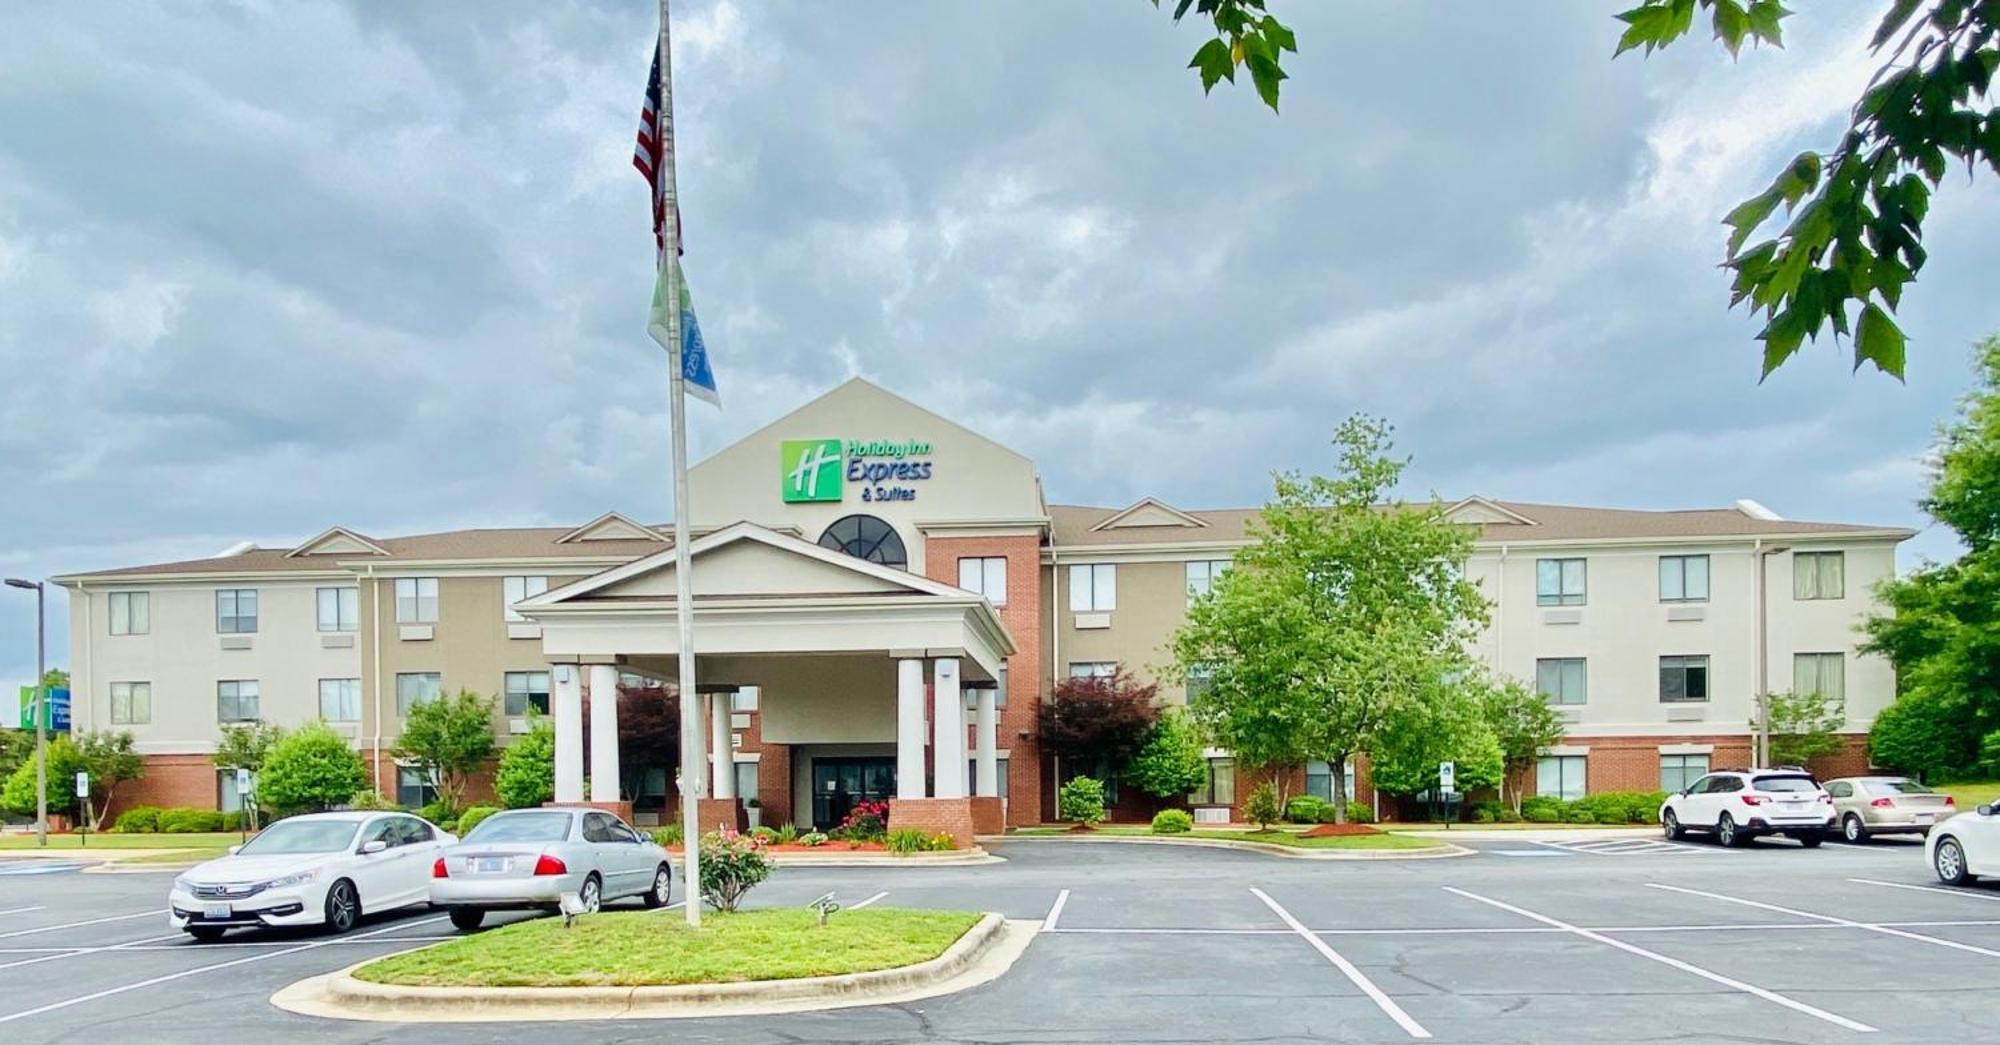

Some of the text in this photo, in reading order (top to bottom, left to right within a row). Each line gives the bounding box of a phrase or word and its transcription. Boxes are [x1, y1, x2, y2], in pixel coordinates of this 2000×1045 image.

[848, 438, 906, 459] Holiday
[847, 458, 932, 486] Express
[862, 486, 916, 502] & Suites
